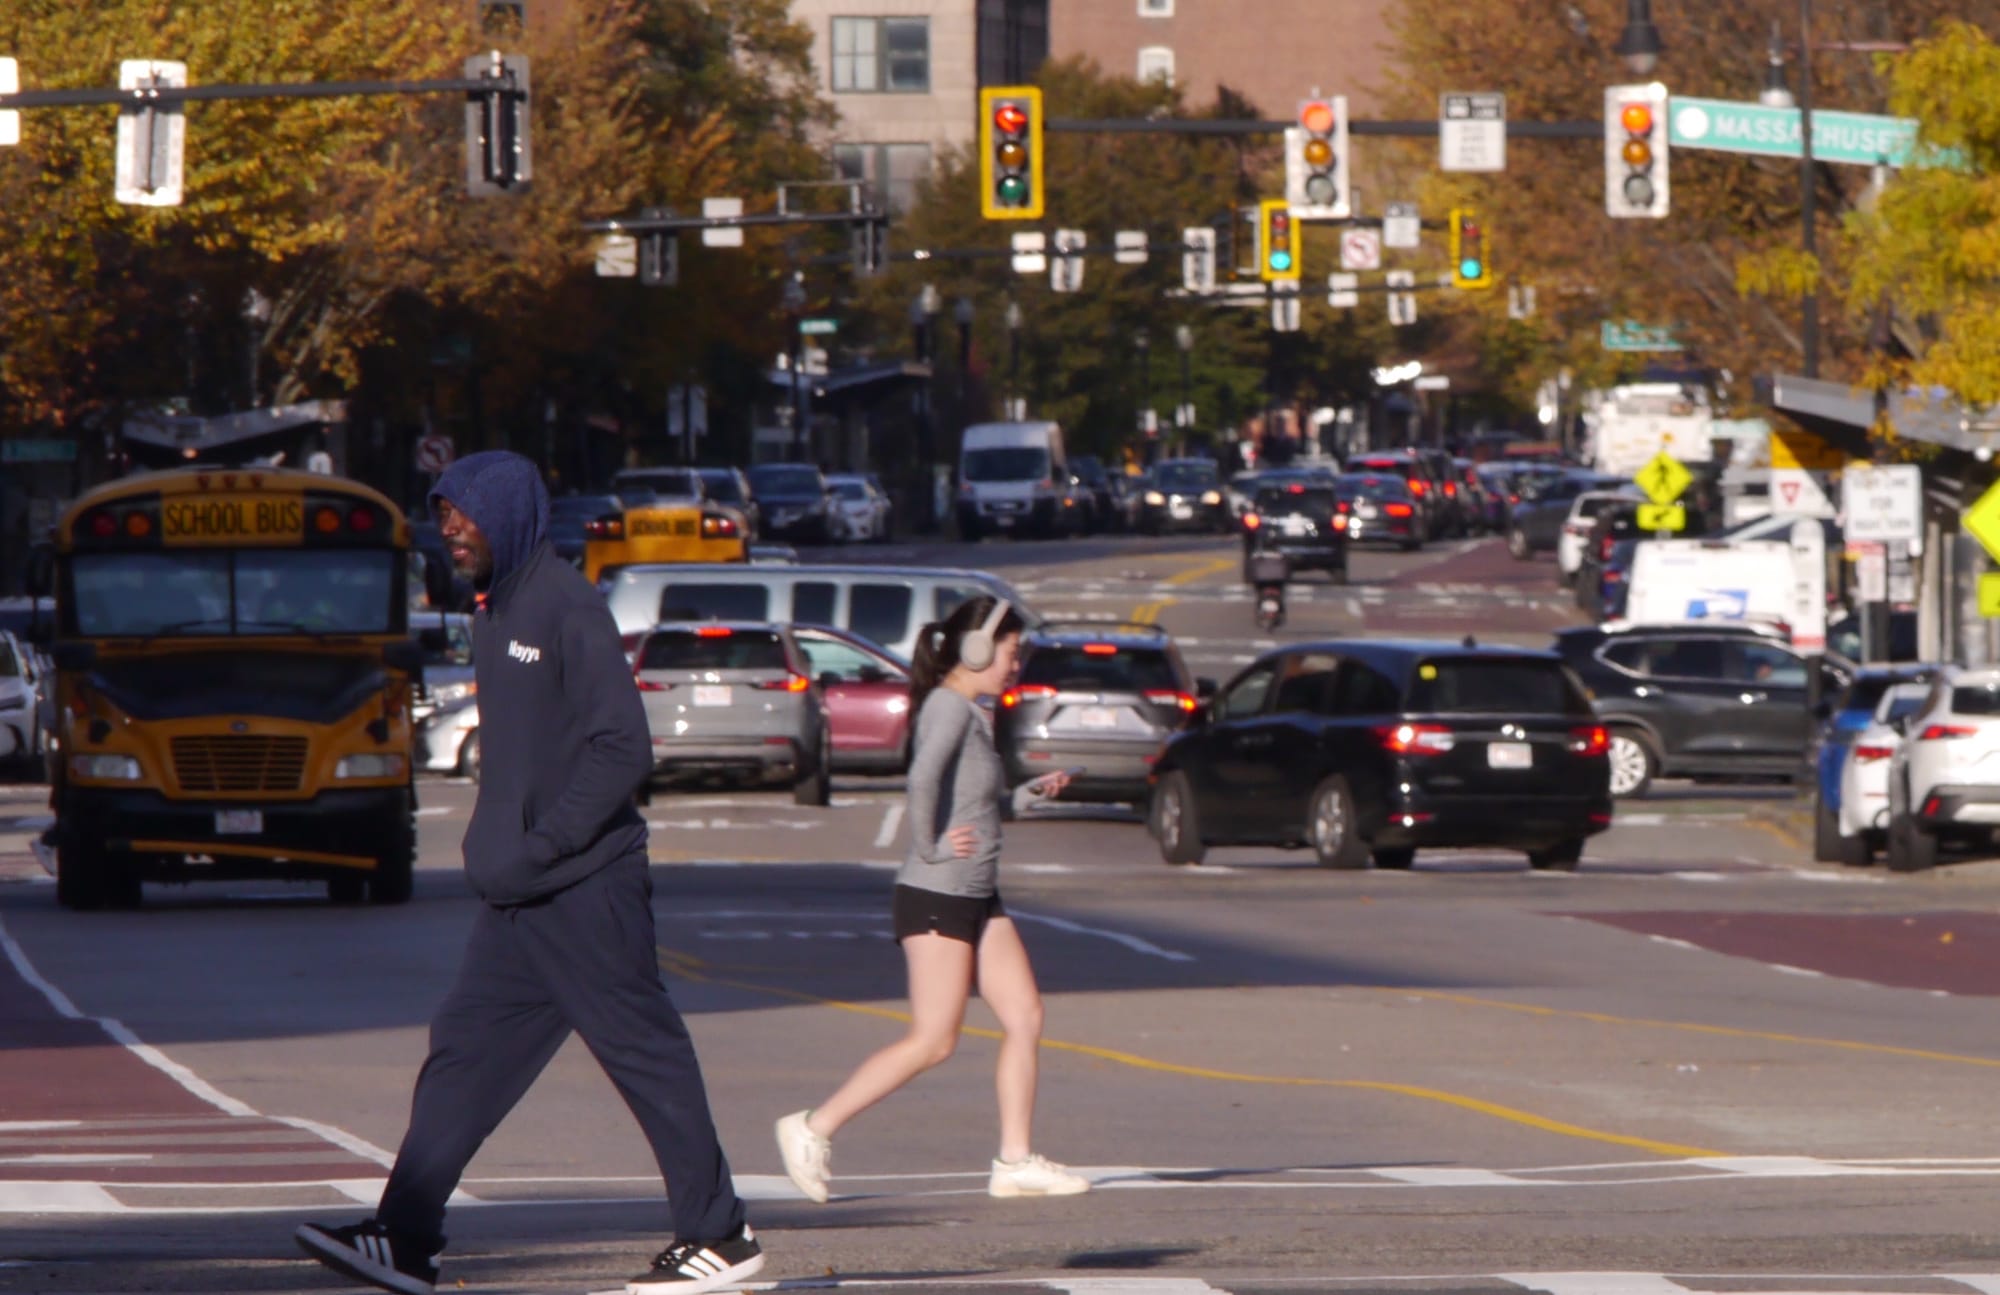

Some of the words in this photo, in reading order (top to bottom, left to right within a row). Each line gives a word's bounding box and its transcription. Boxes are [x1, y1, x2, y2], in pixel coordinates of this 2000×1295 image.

[1714, 112, 1916, 157] MASSACHUSET
[165, 503, 250, 536] SCHOOL
[256, 502, 303, 534] BUS
